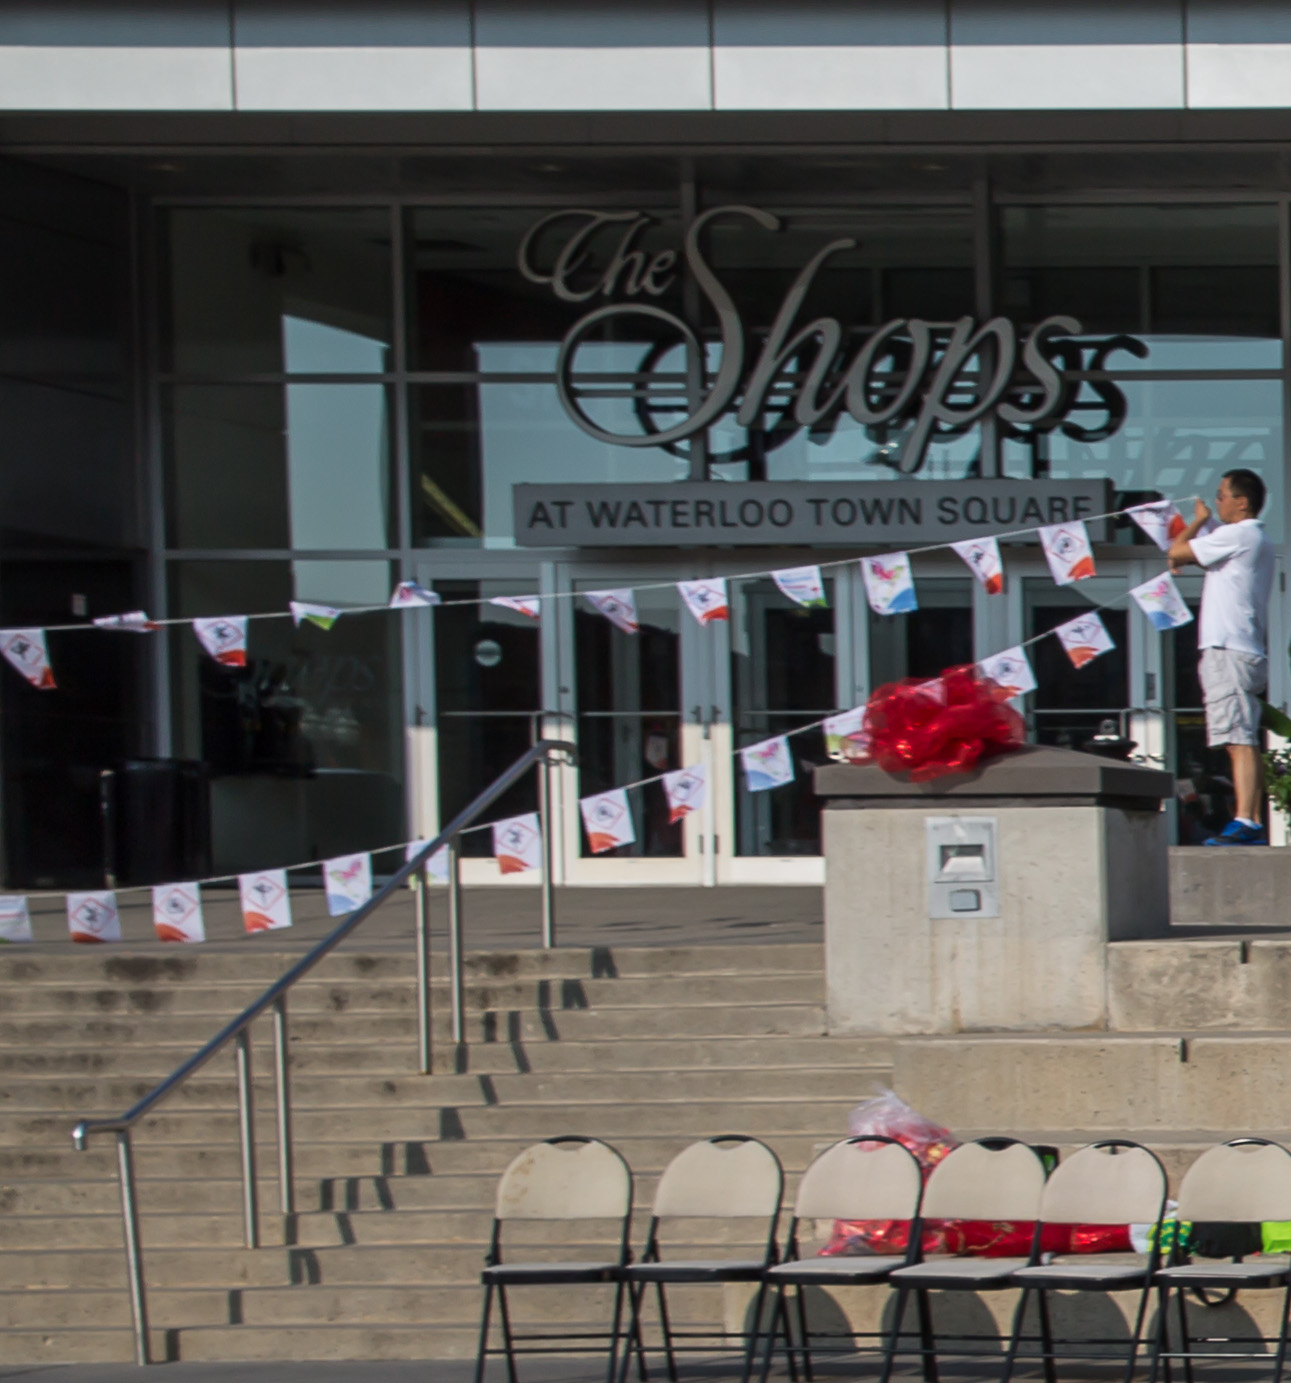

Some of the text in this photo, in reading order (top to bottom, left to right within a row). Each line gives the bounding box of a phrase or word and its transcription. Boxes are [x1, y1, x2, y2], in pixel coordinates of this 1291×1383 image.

[519, 205, 1083, 472] The Shops
[528, 496, 1093, 528] AT WATERLOO TOWN SQUARE
